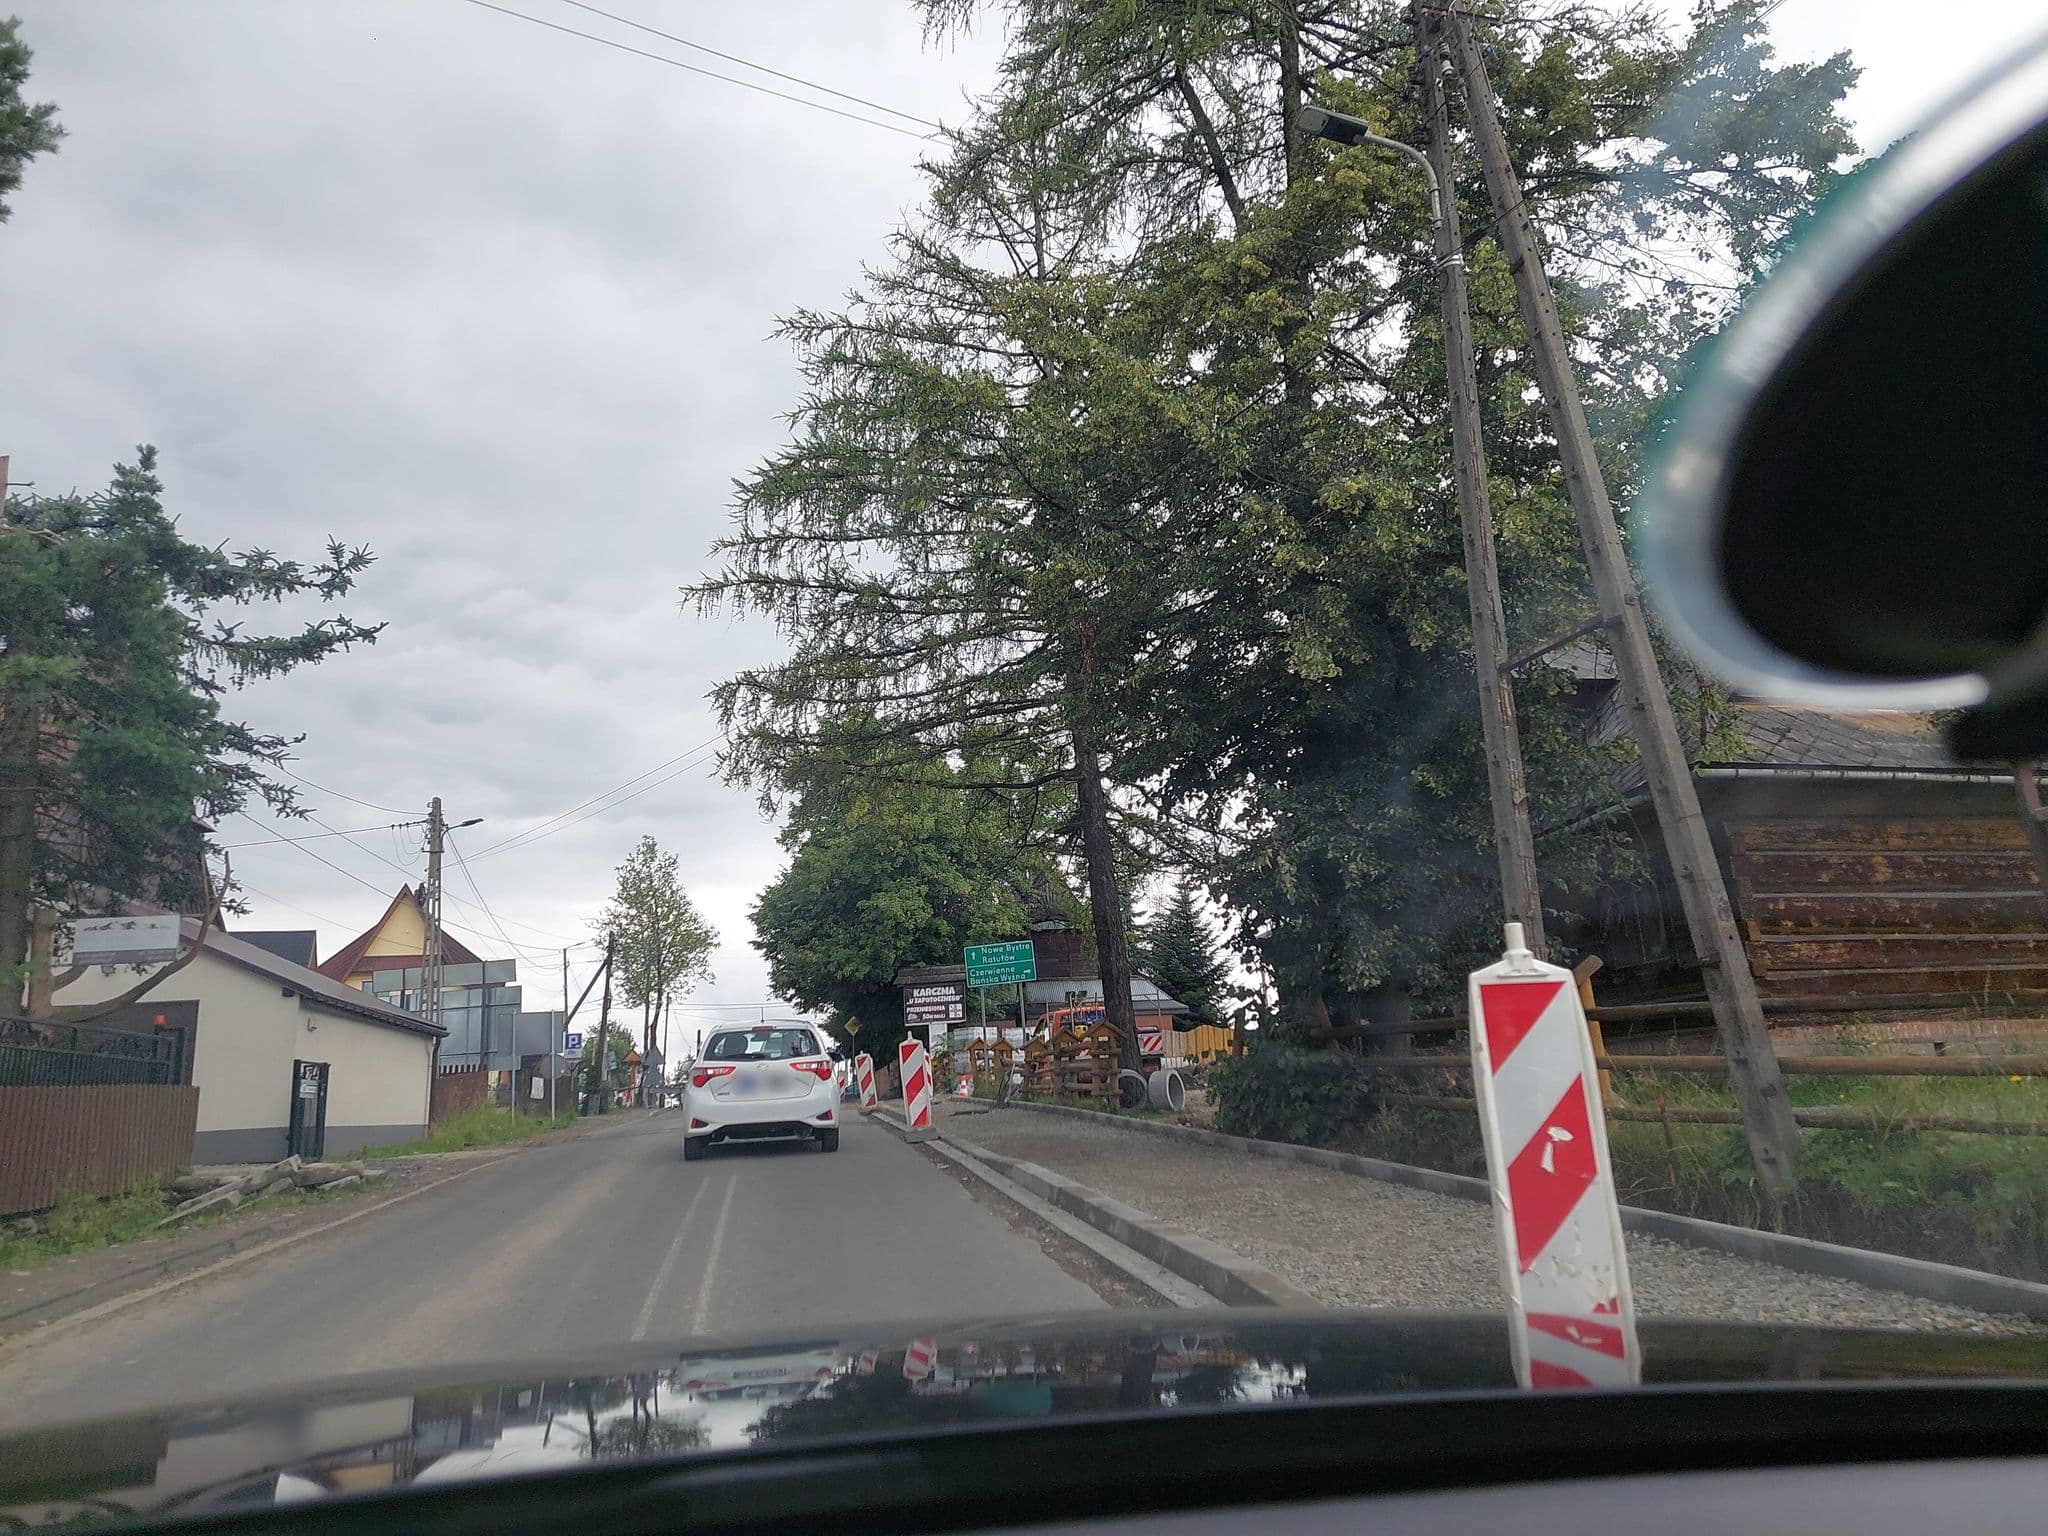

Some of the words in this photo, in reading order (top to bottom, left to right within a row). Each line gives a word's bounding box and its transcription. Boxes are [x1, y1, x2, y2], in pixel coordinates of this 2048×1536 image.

[981, 946, 1004, 955] Nowe
[1006, 943, 1030, 953] Bystre
[969, 966, 1015, 977] Czerwienne
[913, 986, 956, 997] KARCZMA
[568, 1035, 578, 1048] P
